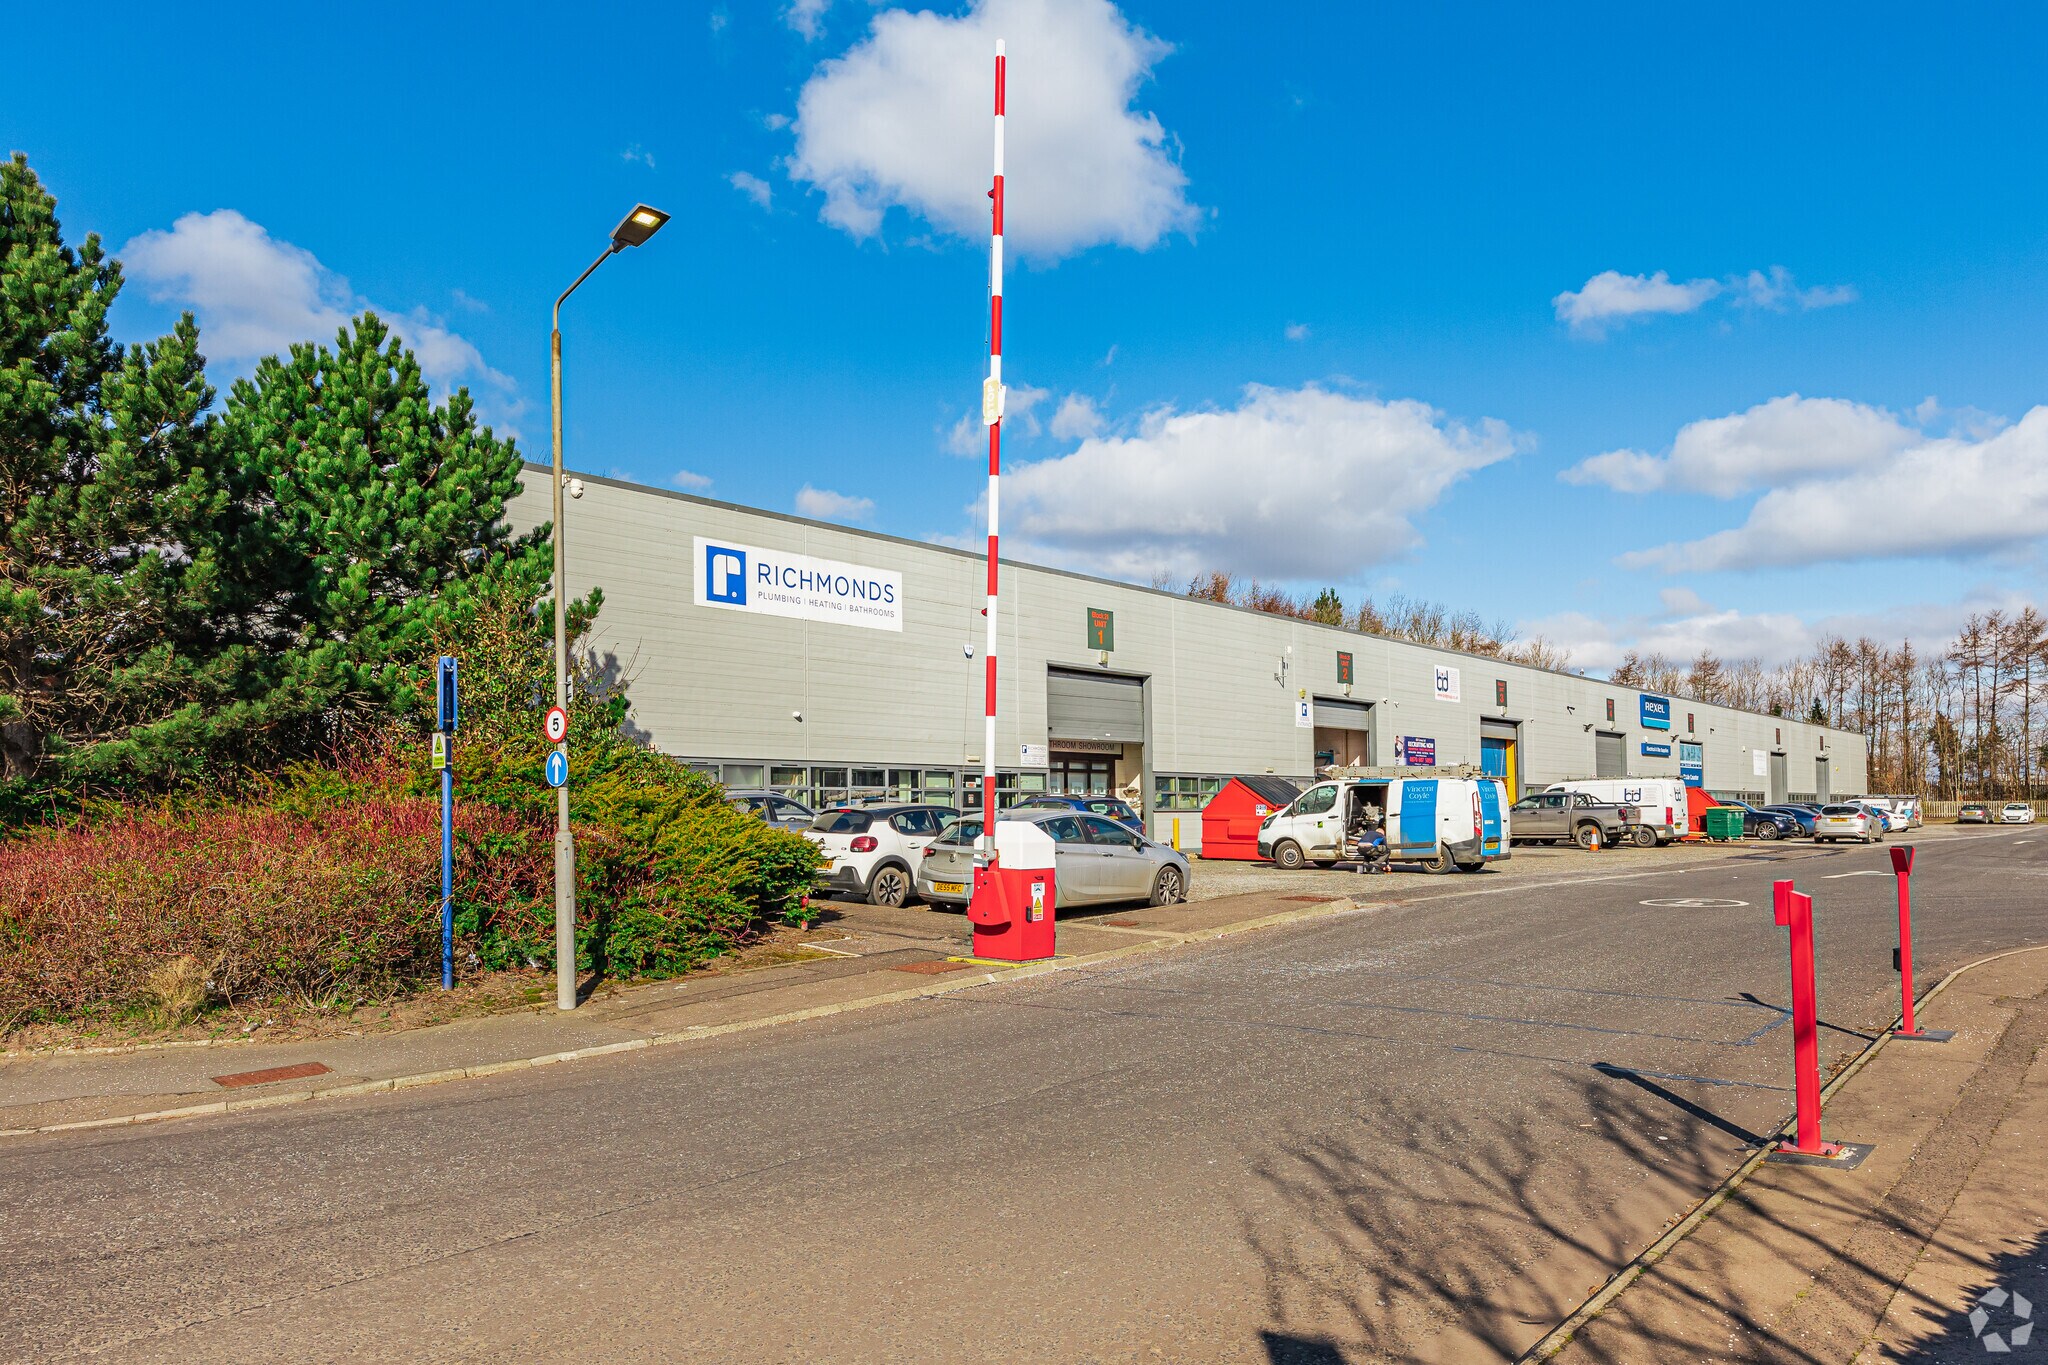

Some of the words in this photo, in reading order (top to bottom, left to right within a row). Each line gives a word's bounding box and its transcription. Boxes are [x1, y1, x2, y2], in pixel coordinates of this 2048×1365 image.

[757, 562, 895, 603] RICHMONDS
[757, 591, 801, 605] PLUMBING
[808, 598, 842, 611] HEATING
[849, 604, 895, 618] BATHROOMS
[1097, 629, 1104, 645] 1
[1342, 667, 1349, 680] 2
[552, 717, 560, 732] 5
[1078, 742, 1115, 751] SHOWROOM
[1408, 792, 1430, 801] Coyle
[1624, 788, 1642, 802] bid
